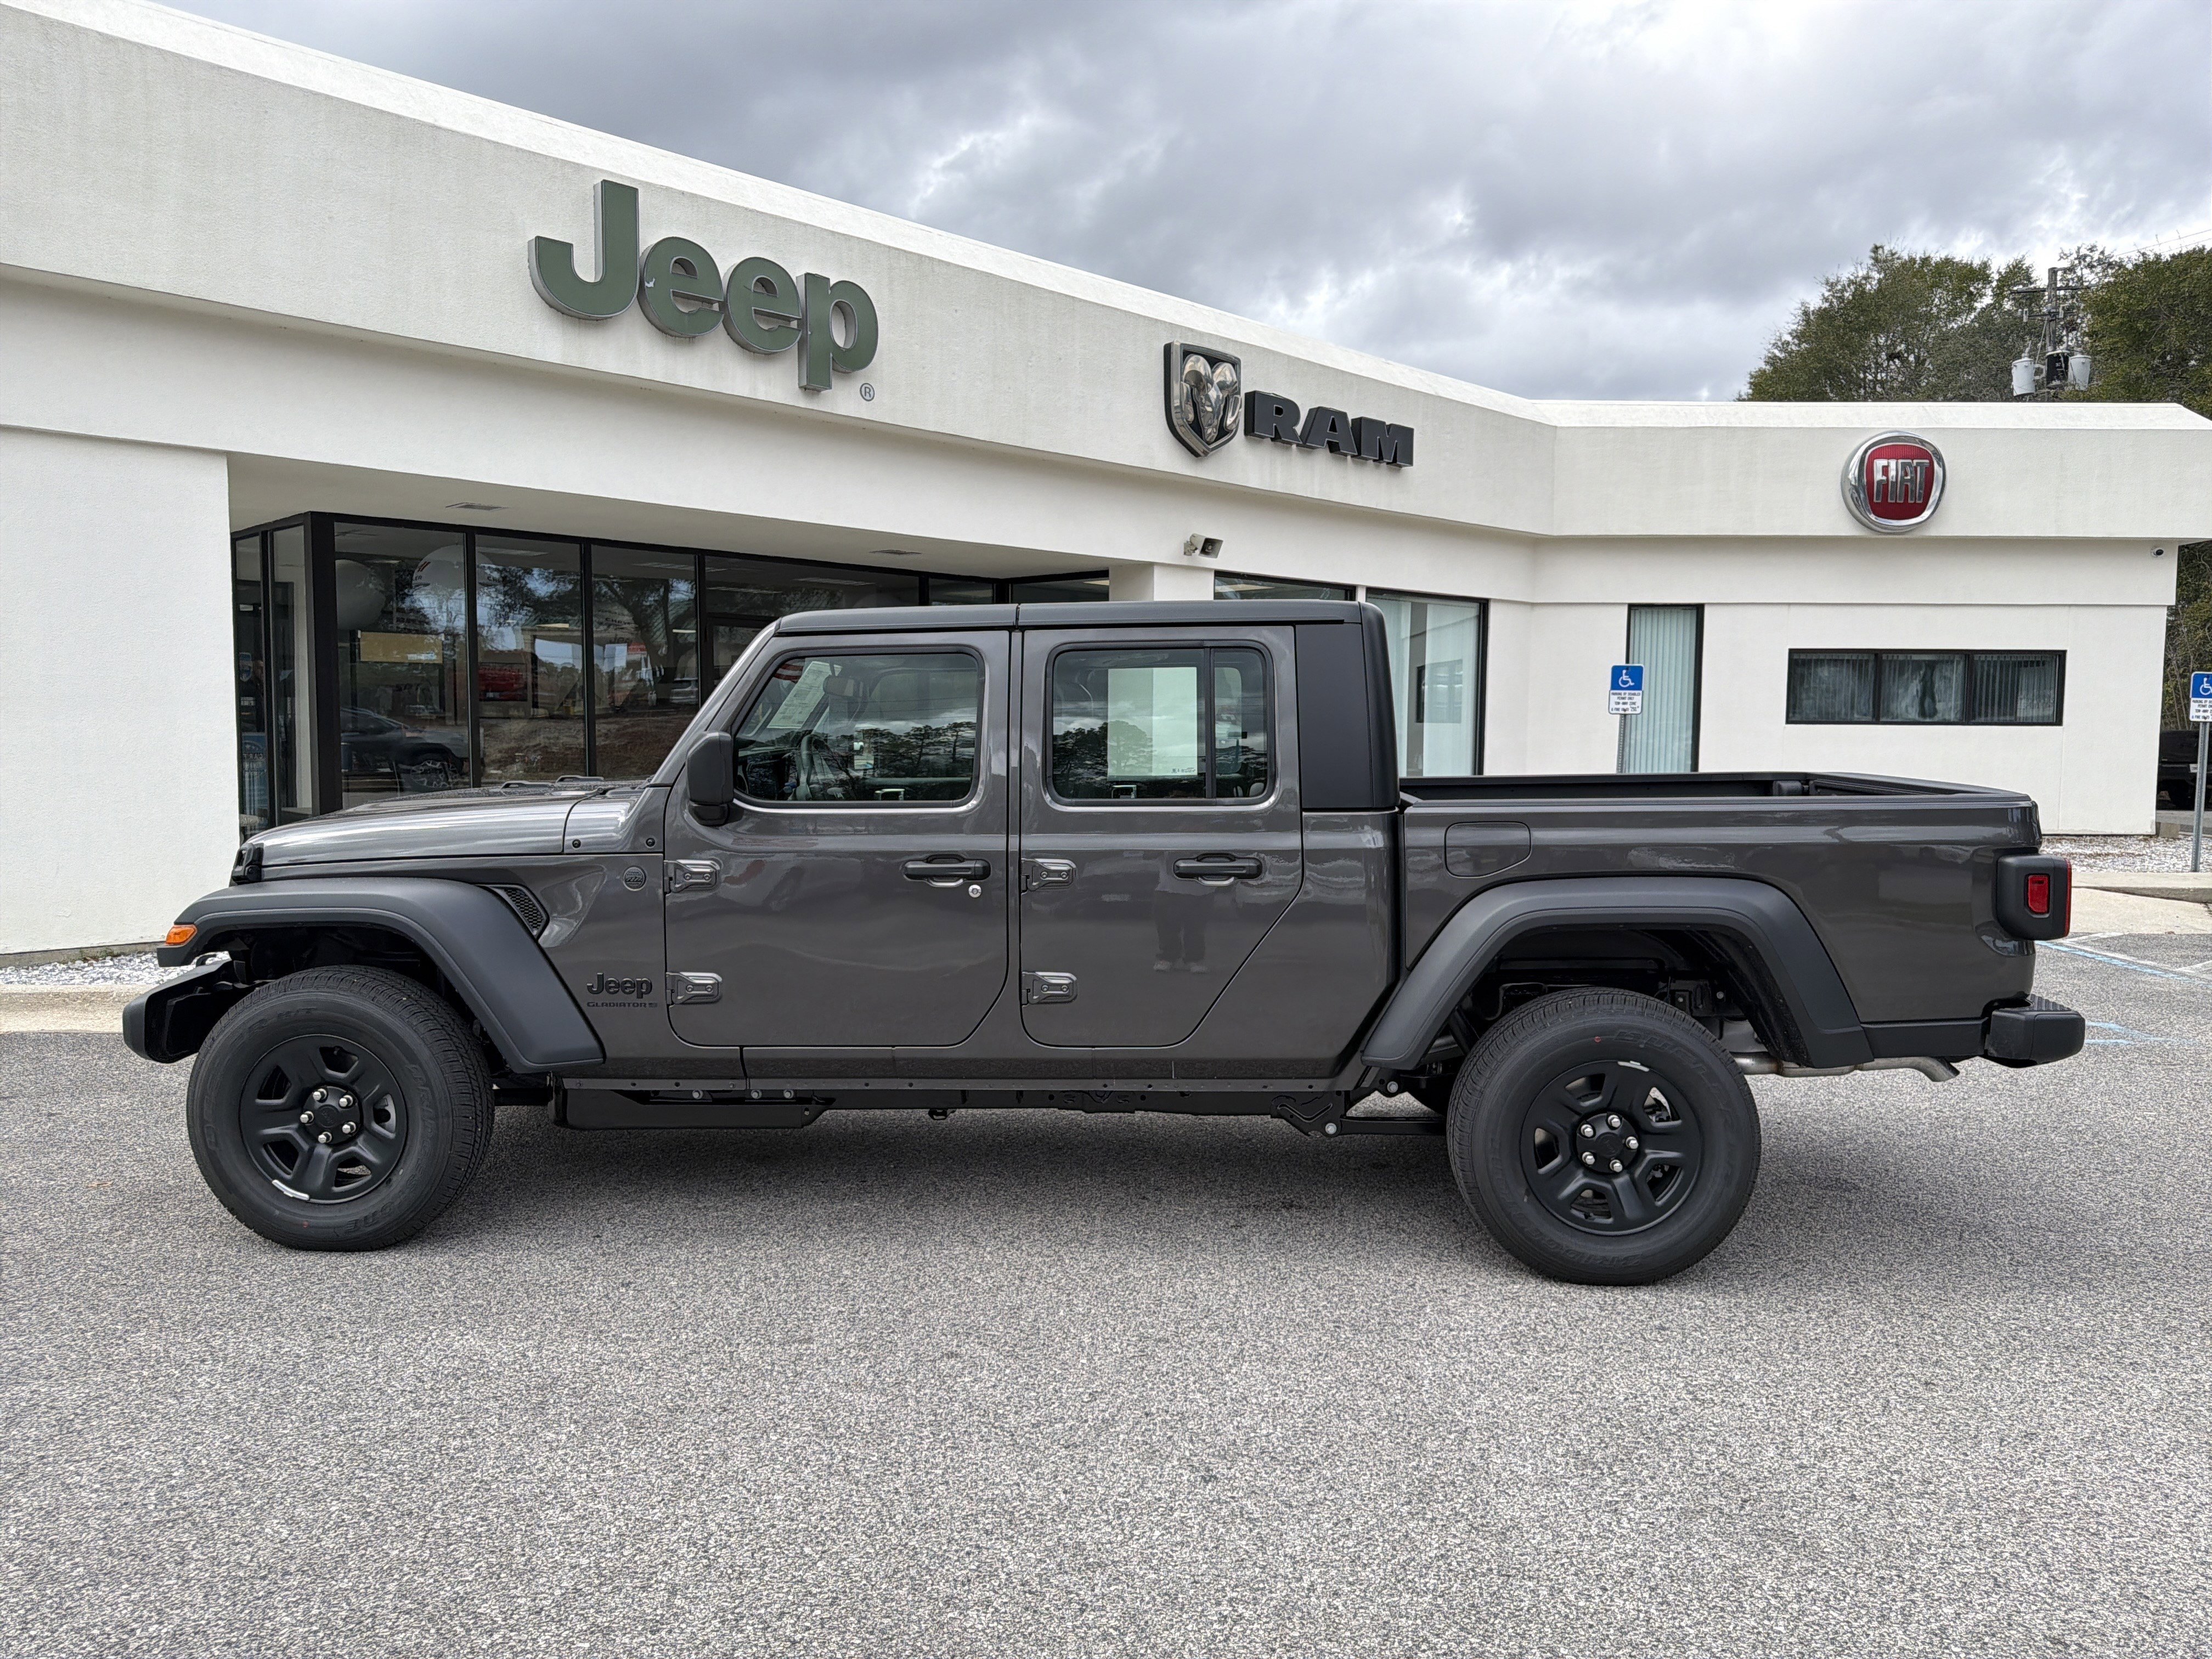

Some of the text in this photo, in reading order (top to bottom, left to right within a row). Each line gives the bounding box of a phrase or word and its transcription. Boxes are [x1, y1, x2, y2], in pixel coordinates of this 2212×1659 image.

[528, 179, 878, 391] Jeep
[1243, 390, 1415, 468] RAM
[1873, 459, 1929, 504] FIAT
[586, 972, 653, 999] Jeep
